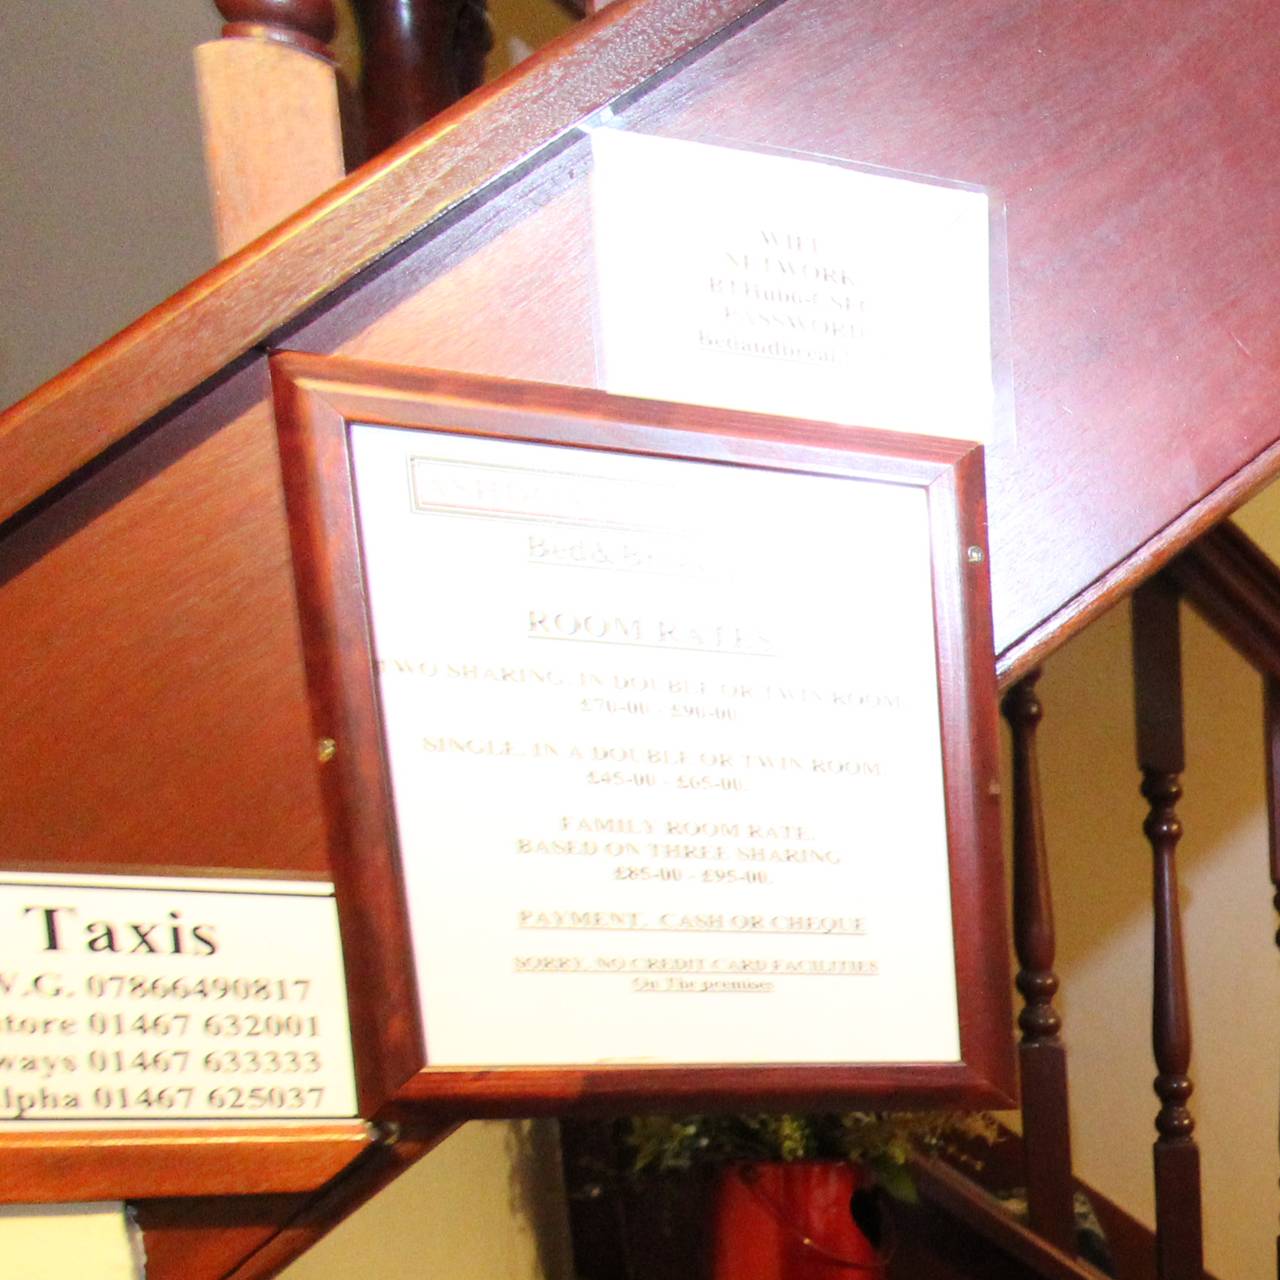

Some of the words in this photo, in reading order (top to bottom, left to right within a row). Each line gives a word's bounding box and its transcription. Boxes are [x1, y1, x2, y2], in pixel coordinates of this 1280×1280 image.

[723, 306, 865, 338] PASSWORD
[527, 608, 643, 641] ROOM
[657, 619, 775, 651] RATES
[613, 673, 708, 694] DOUBLE
[720, 682, 753, 699] OR
[763, 685, 824, 704] TWIN
[532, 738, 561, 757] IN
[567, 743, 584, 761] A
[591, 745, 689, 765] DOUBLE
[699, 752, 735, 769] OR
[743, 753, 804, 770] TWIN
[560, 816, 654, 834] FAMILY
[666, 819, 742, 838] ROOM
[514, 837, 599, 857] BASED
[604, 841, 641, 859] ON
[648, 843, 728, 861] THREE
[736, 847, 842, 866] SHARING
[24, 905, 219, 955] Taxis
[657, 912, 726, 930] CASH
[731, 913, 765, 931] OR
[769, 913, 868, 934] CHEQUE
[597, 957, 626, 973] NO
[628, 957, 705, 974] CREDIT
[711, 959, 770, 974] CARD
[773, 959, 881, 976] FACILITIES
[86, 975, 311, 1000] 07866490817
[89, 1012, 191, 1036] 01467
[203, 1014, 320, 1037] 632001
[89, 1050, 191, 1072] 01467
[203, 1050, 322, 1073] 633333
[93, 1087, 195, 1109] 01467
[207, 1087, 326, 1110] 625037
